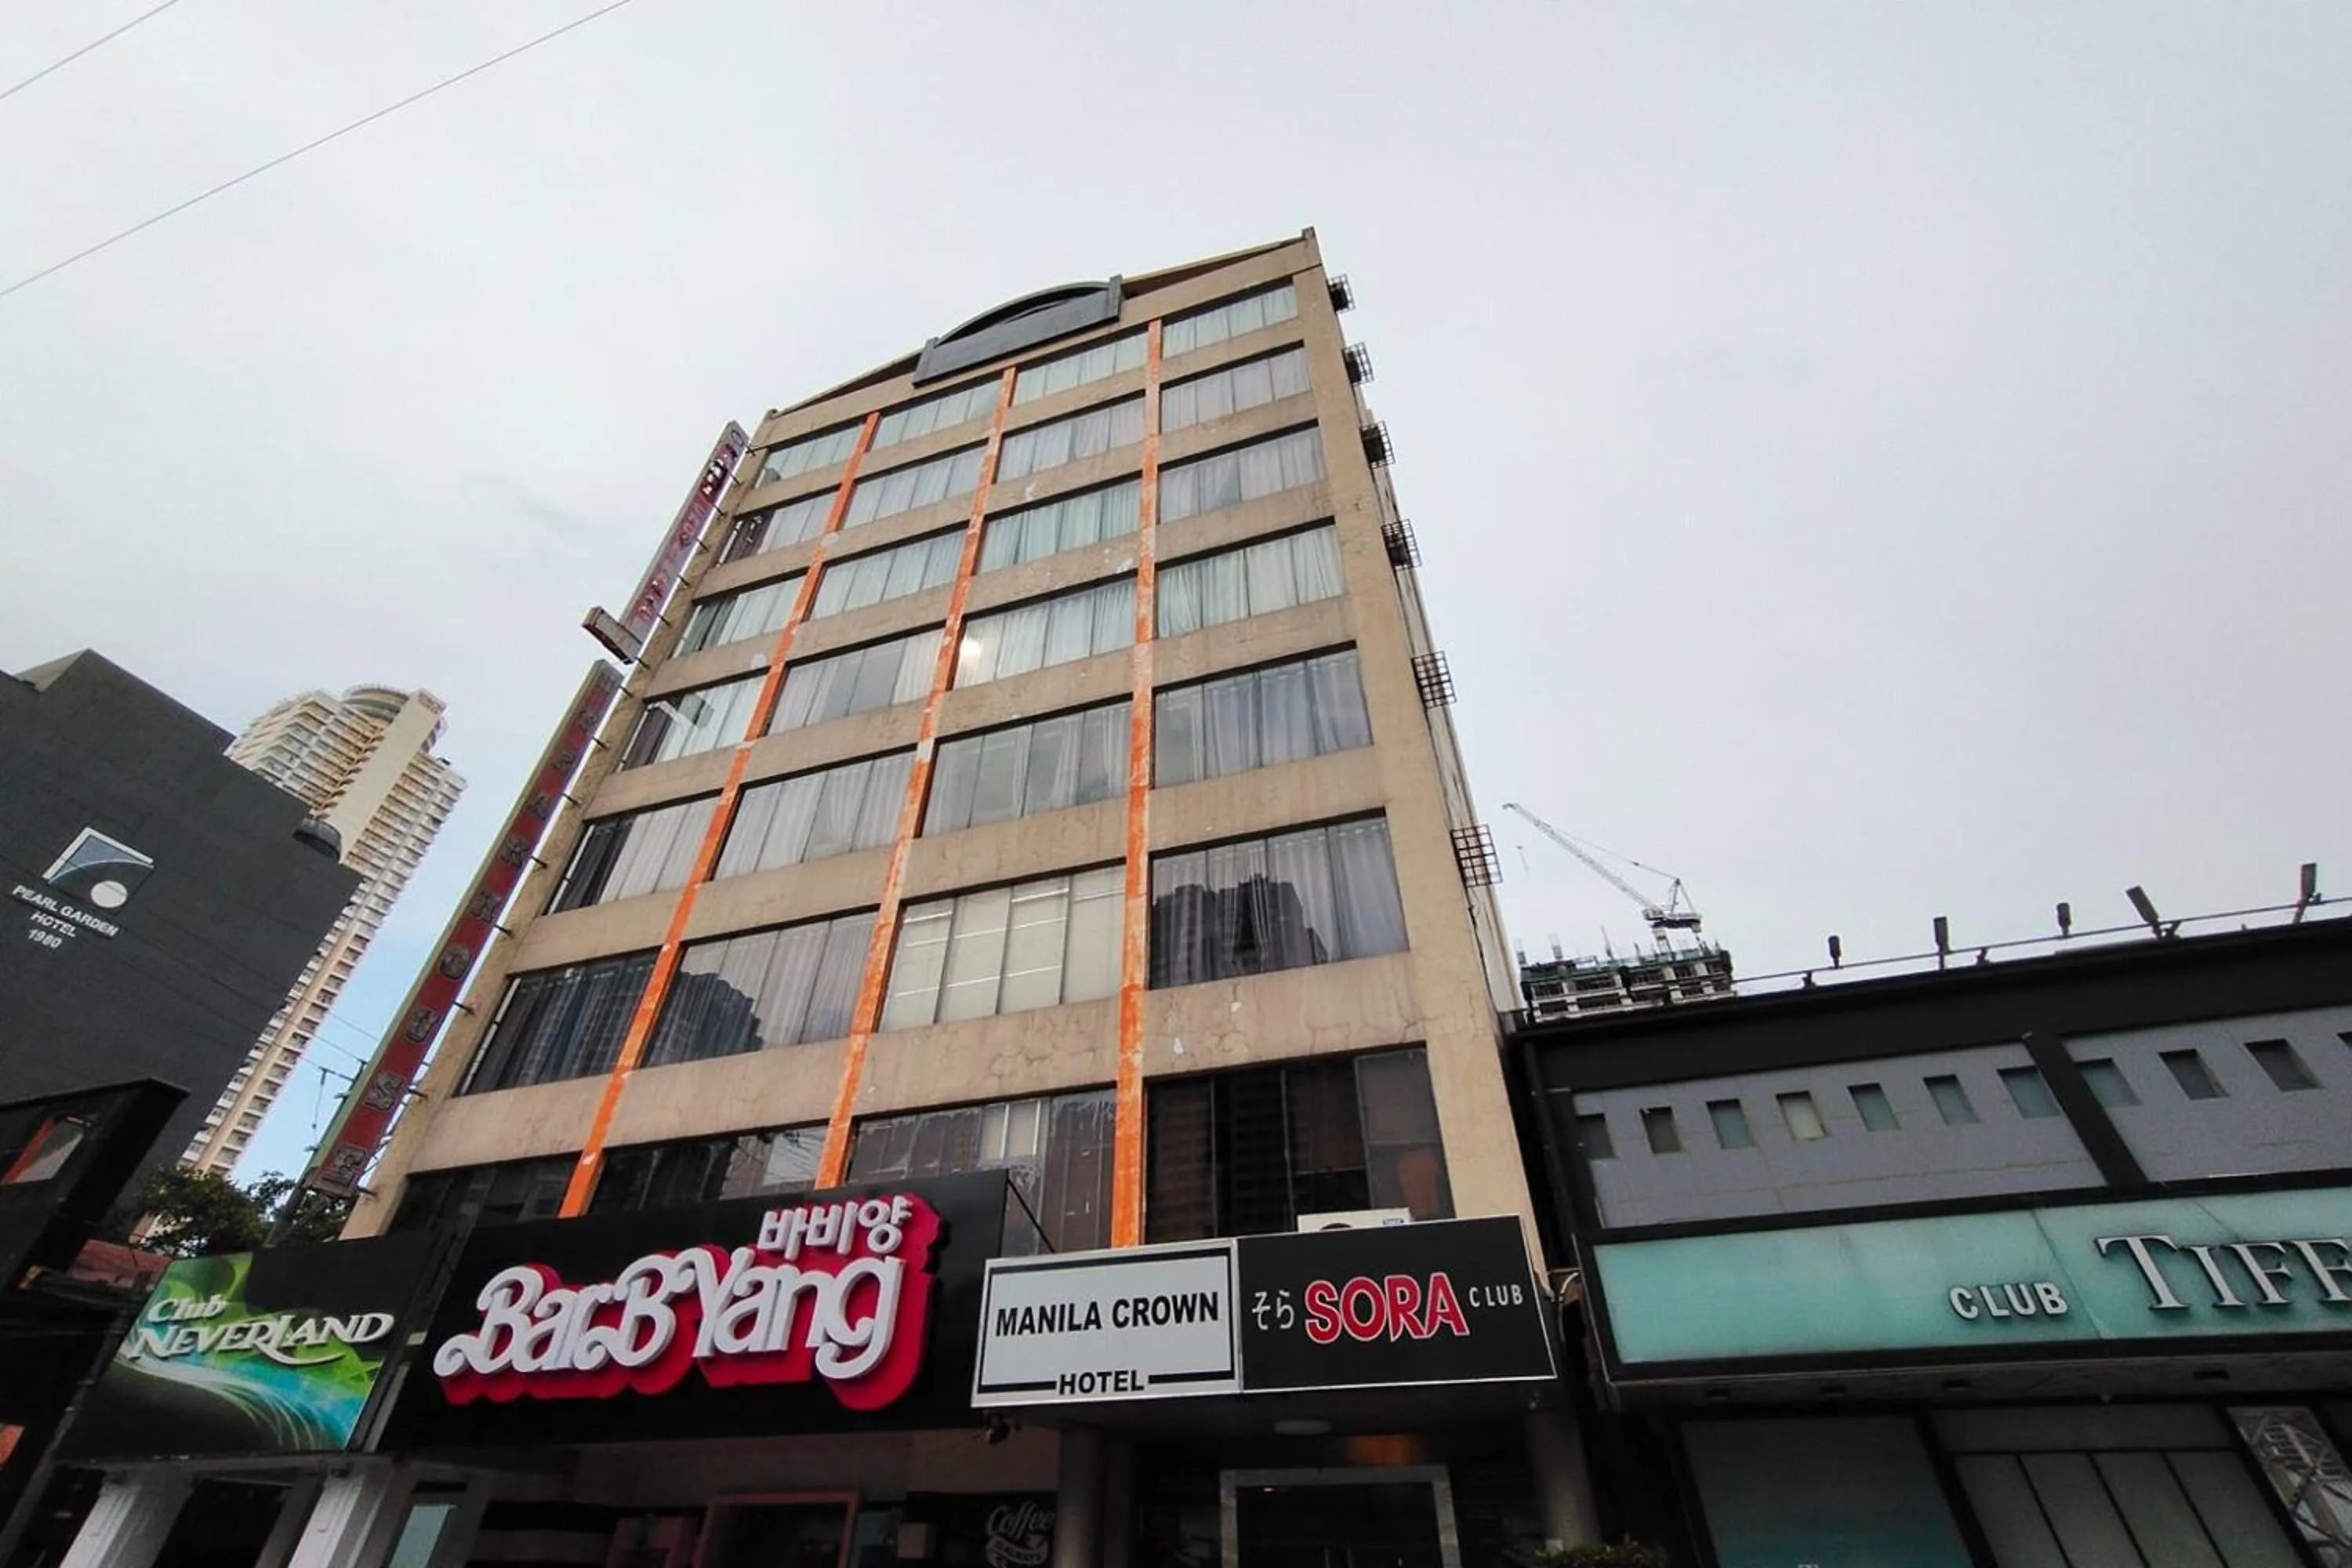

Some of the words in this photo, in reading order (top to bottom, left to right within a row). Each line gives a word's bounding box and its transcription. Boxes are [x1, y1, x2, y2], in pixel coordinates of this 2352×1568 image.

[12, 884, 58, 912] PEARL
[60, 905, 119, 937] GARDEN
[30, 910, 76, 938] HOTEL
[757, 1195, 913, 1259] 바비양
[147, 1294, 227, 1323] Club
[996, 1301, 1102, 1337] MANILA
[1112, 1291, 1219, 1329] CROWN
[1252, 1290, 1295, 1330] そら
[1304, 1272, 1471, 1345] SORA
[1468, 1283, 1525, 1308] CLUB
[1947, 1281, 2068, 1320] CLUB
[126, 1312, 394, 1366] NEVERLAND
[1059, 1370, 1145, 1396] HOTEL
[985, 1499, 1055, 1541] Coffee
